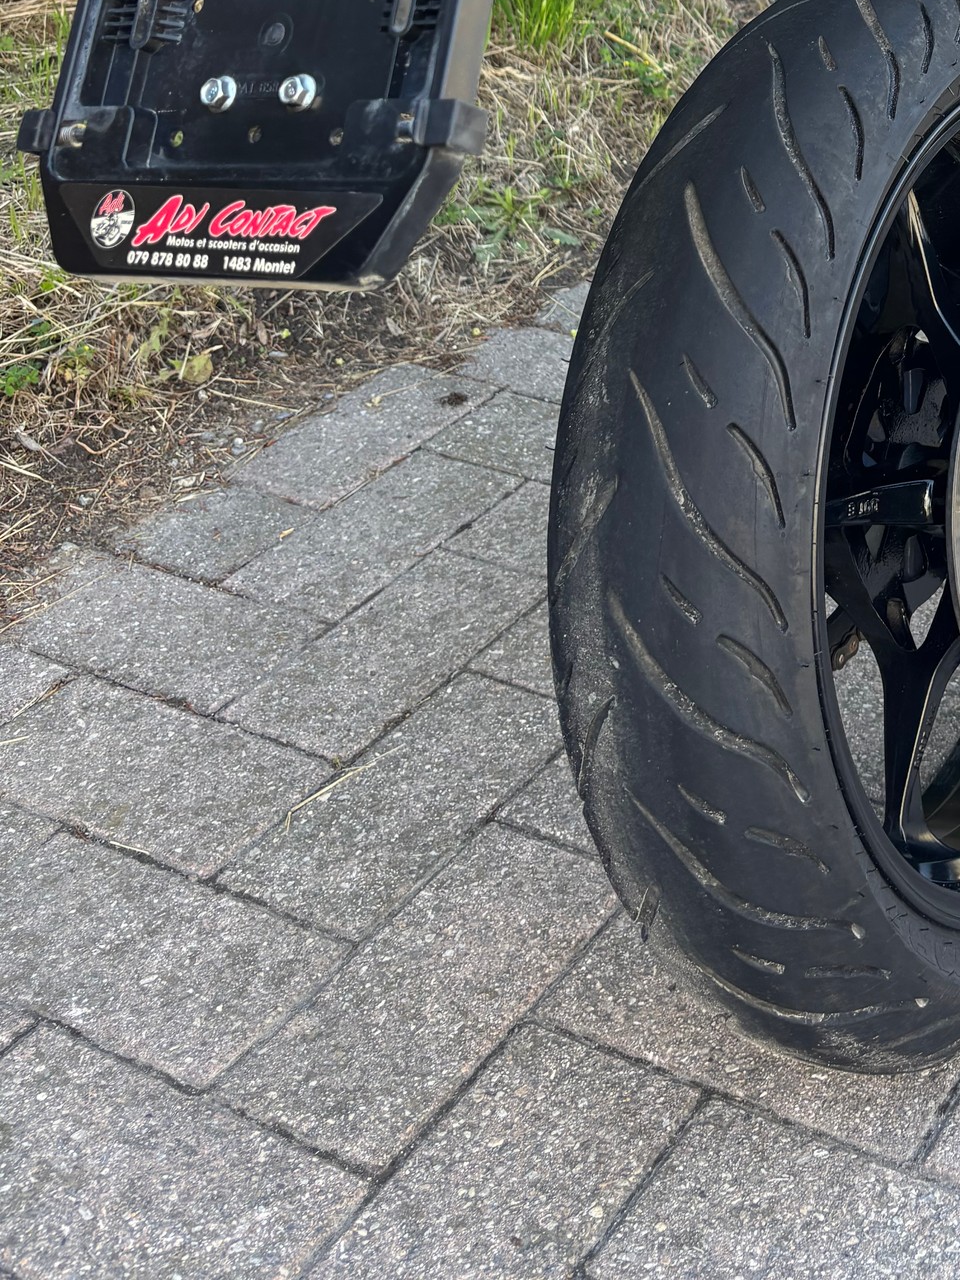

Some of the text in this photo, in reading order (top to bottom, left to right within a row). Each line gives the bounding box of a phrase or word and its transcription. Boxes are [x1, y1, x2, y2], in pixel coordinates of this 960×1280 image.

[166, 235, 300, 253] Motos et scooters d'occasion
[126, 250, 209, 269] 079 878 80 88
[223, 255, 296, 274] 1483 Montet
